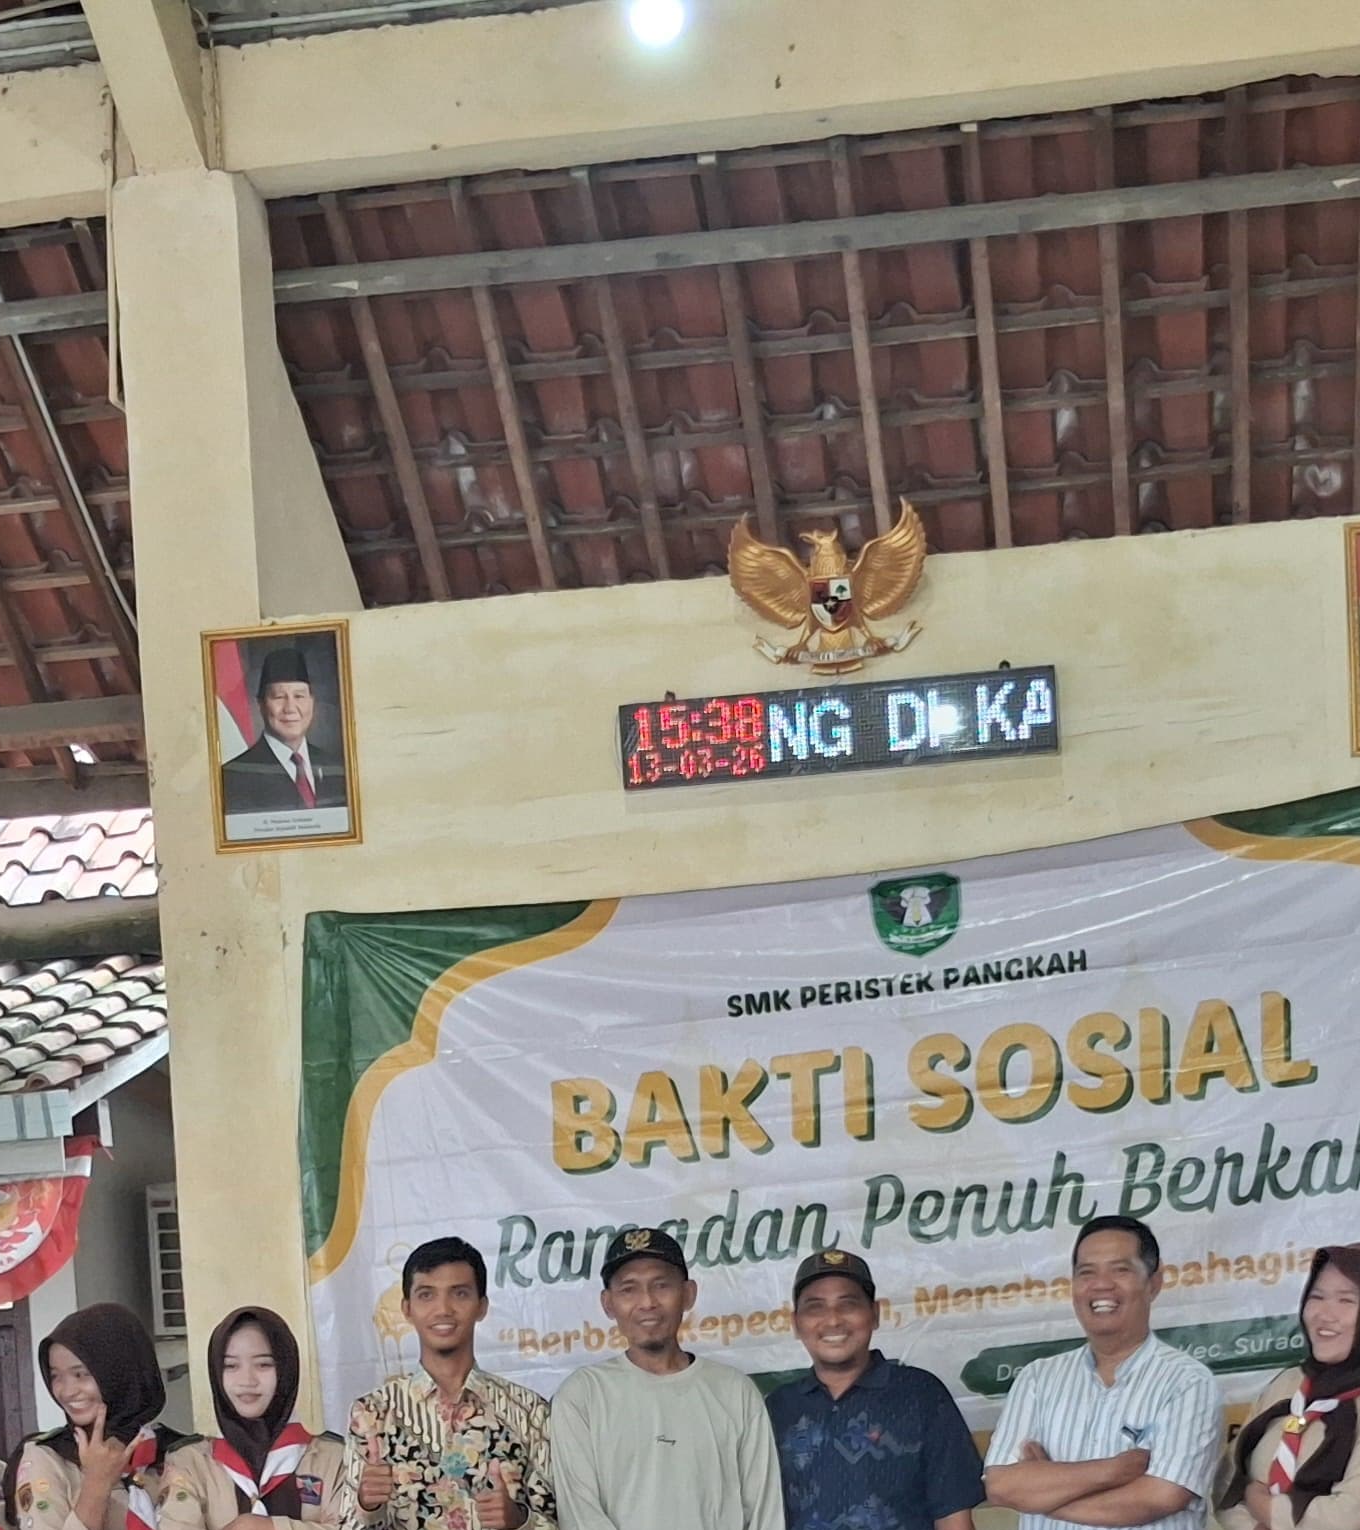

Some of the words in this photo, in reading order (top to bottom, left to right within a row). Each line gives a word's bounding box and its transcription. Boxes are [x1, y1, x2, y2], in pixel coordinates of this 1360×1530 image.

[633, 698, 764, 752] 15:38
[768, 699, 852, 763] NG
[975, 677, 1054, 744] KA
[727, 989, 792, 1018] SMK
[800, 971, 935, 1009] PERISTEK
[944, 949, 1088, 990] PANGKAH
[550, 1044, 875, 1175] BAKTI
[906, 991, 1318, 1133] SOSIAL
[861, 1151, 1098, 1249] Penuh
